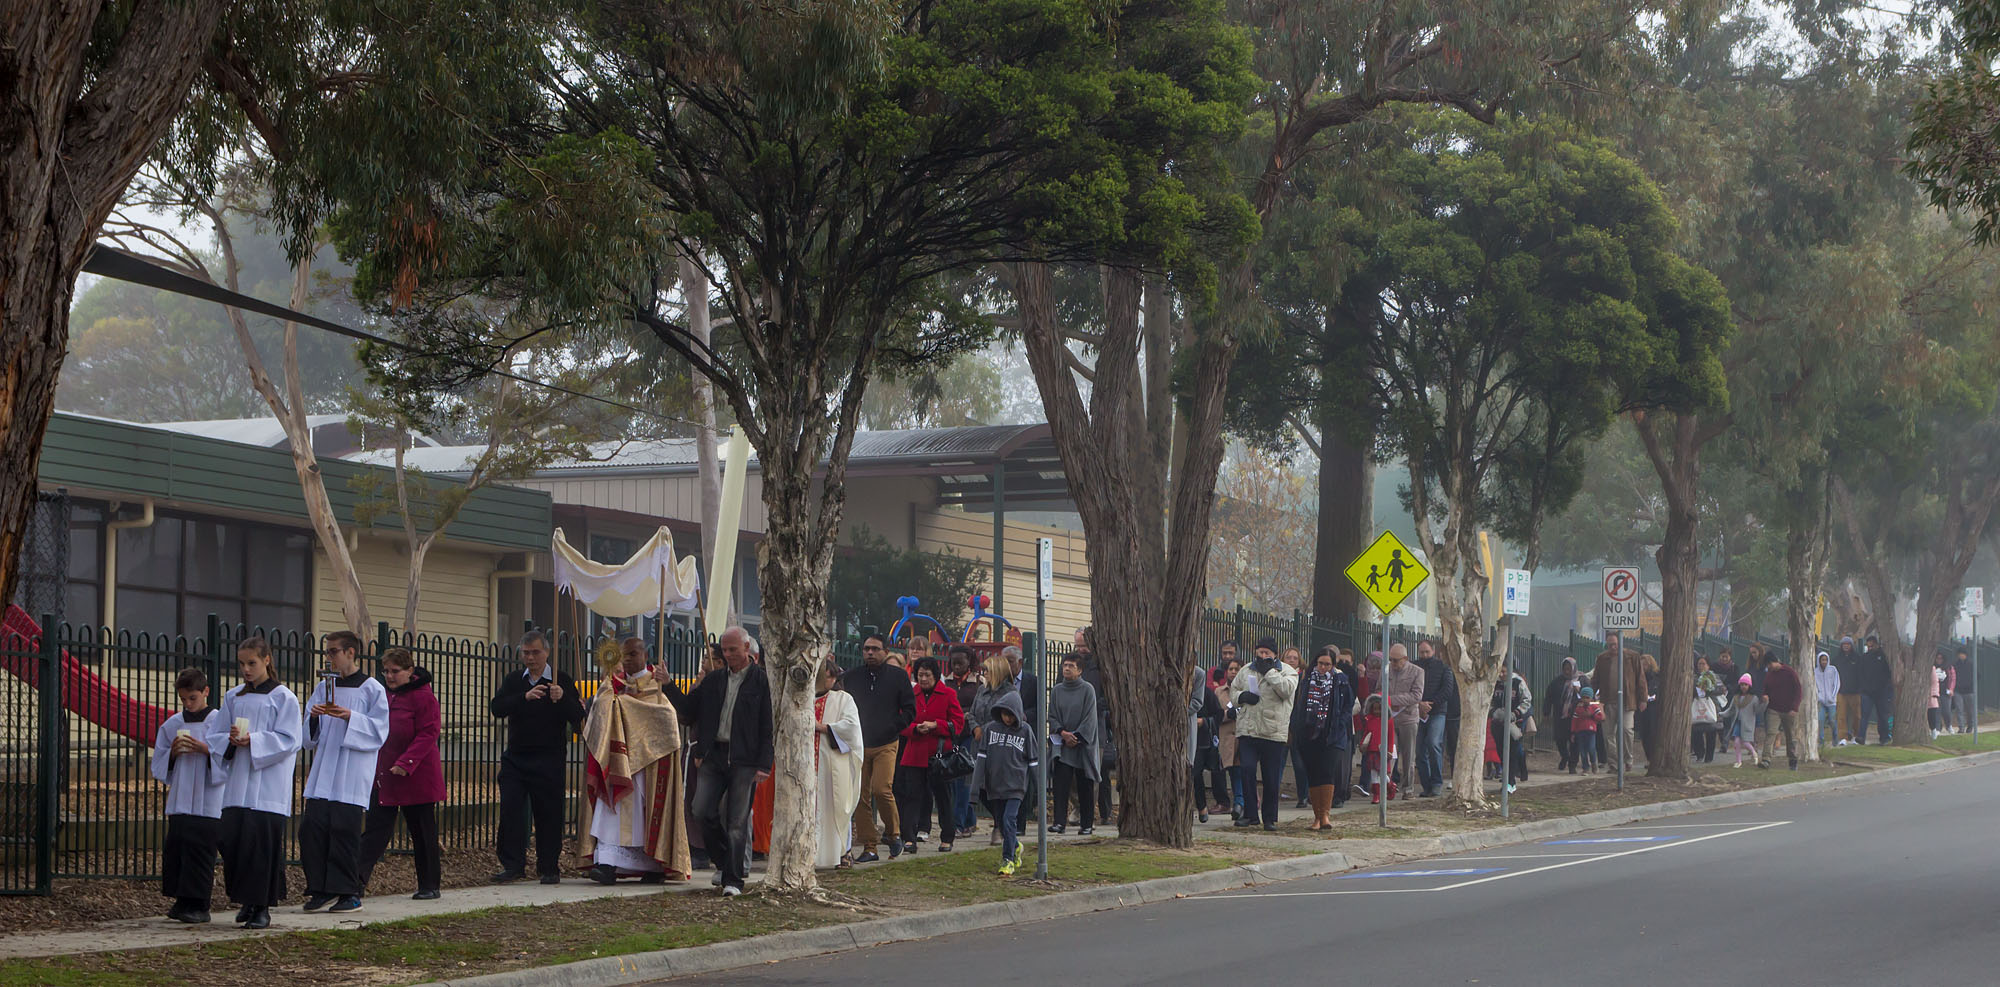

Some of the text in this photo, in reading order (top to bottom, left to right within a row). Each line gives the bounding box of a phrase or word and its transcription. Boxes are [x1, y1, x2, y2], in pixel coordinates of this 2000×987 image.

[1508, 573, 1514, 584] P
[1517, 573, 1524, 584] P
[1605, 602, 1636, 613] NO U
[1605, 616, 1634, 625] TURN
